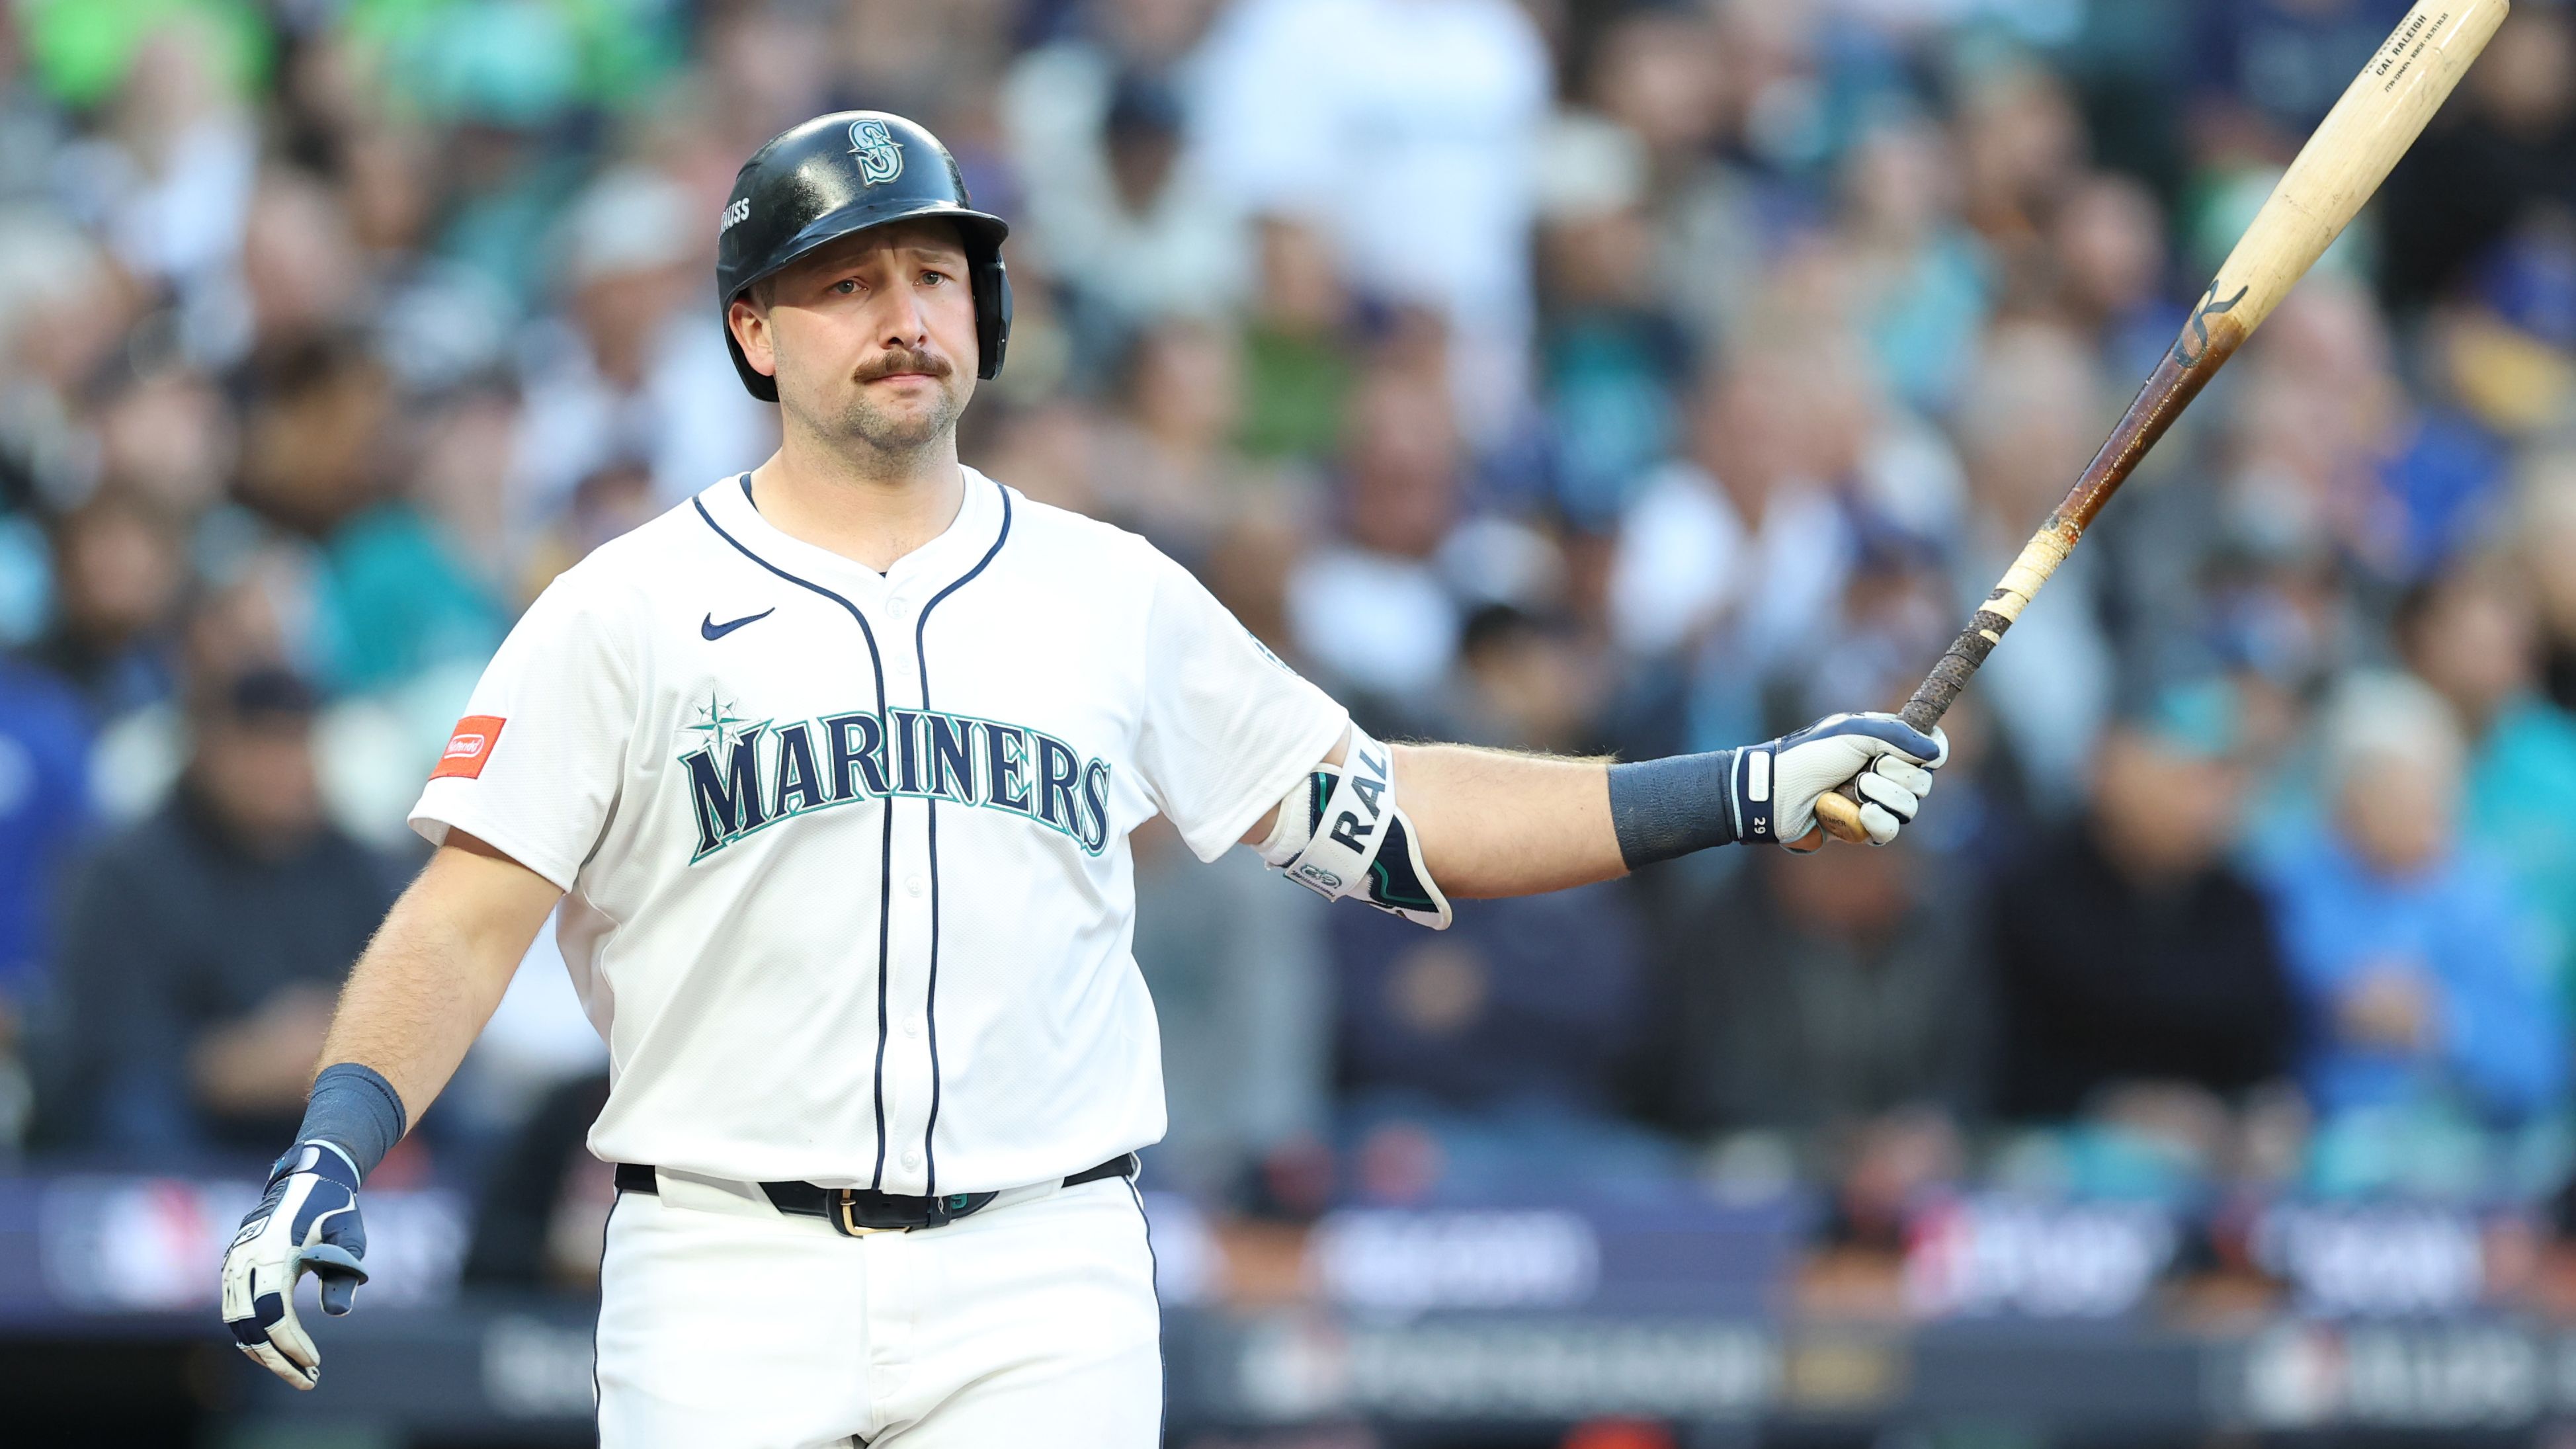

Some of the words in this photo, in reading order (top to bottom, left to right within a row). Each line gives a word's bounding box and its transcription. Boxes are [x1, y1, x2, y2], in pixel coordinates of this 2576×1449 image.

[2376, 58, 2394, 76] CAL
[2392, 14, 2427, 56] RALEIGH
[849, 119, 903, 187] S
[677, 706, 1111, 866] MARINERS
[1329, 743, 1389, 856] RAL
[1754, 817, 1766, 835] 29
